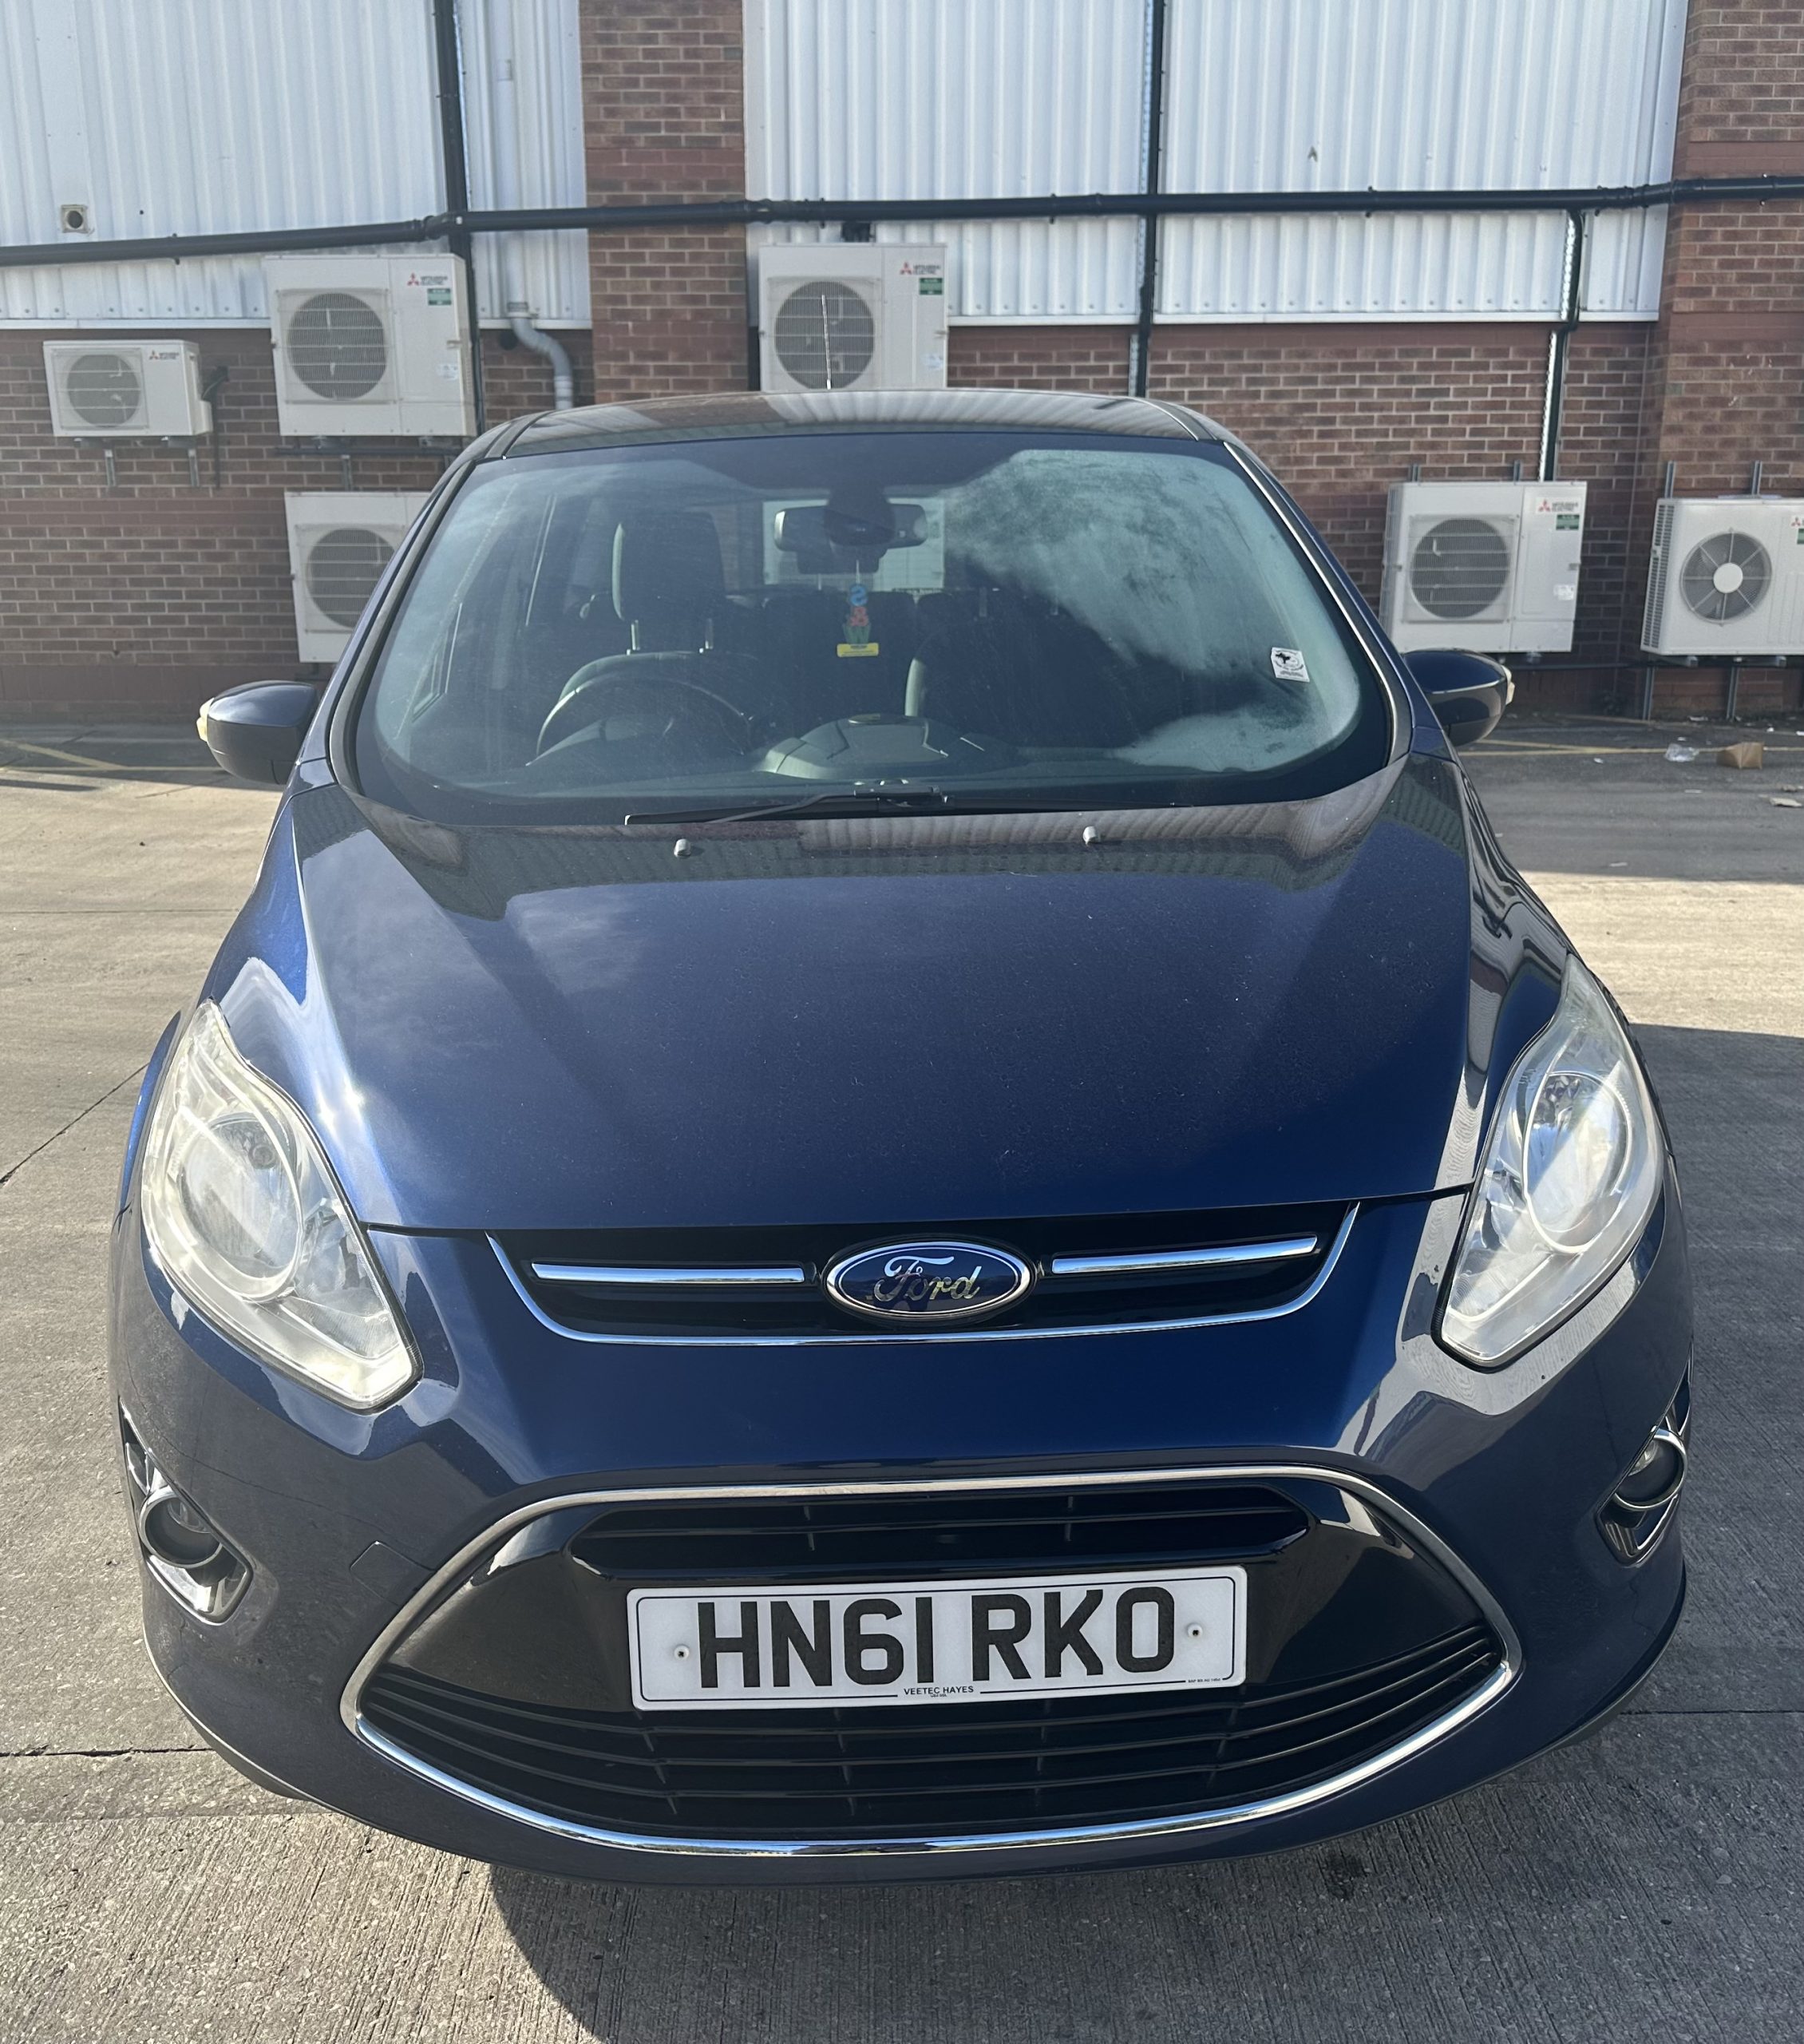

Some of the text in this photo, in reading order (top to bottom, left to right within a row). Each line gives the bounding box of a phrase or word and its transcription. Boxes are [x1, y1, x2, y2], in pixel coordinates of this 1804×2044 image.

[873, 1255, 983, 1302] Ford
[697, 1586, 1175, 1689] HN61 RKO
[904, 1686, 974, 1695] VEETEC HAYES
